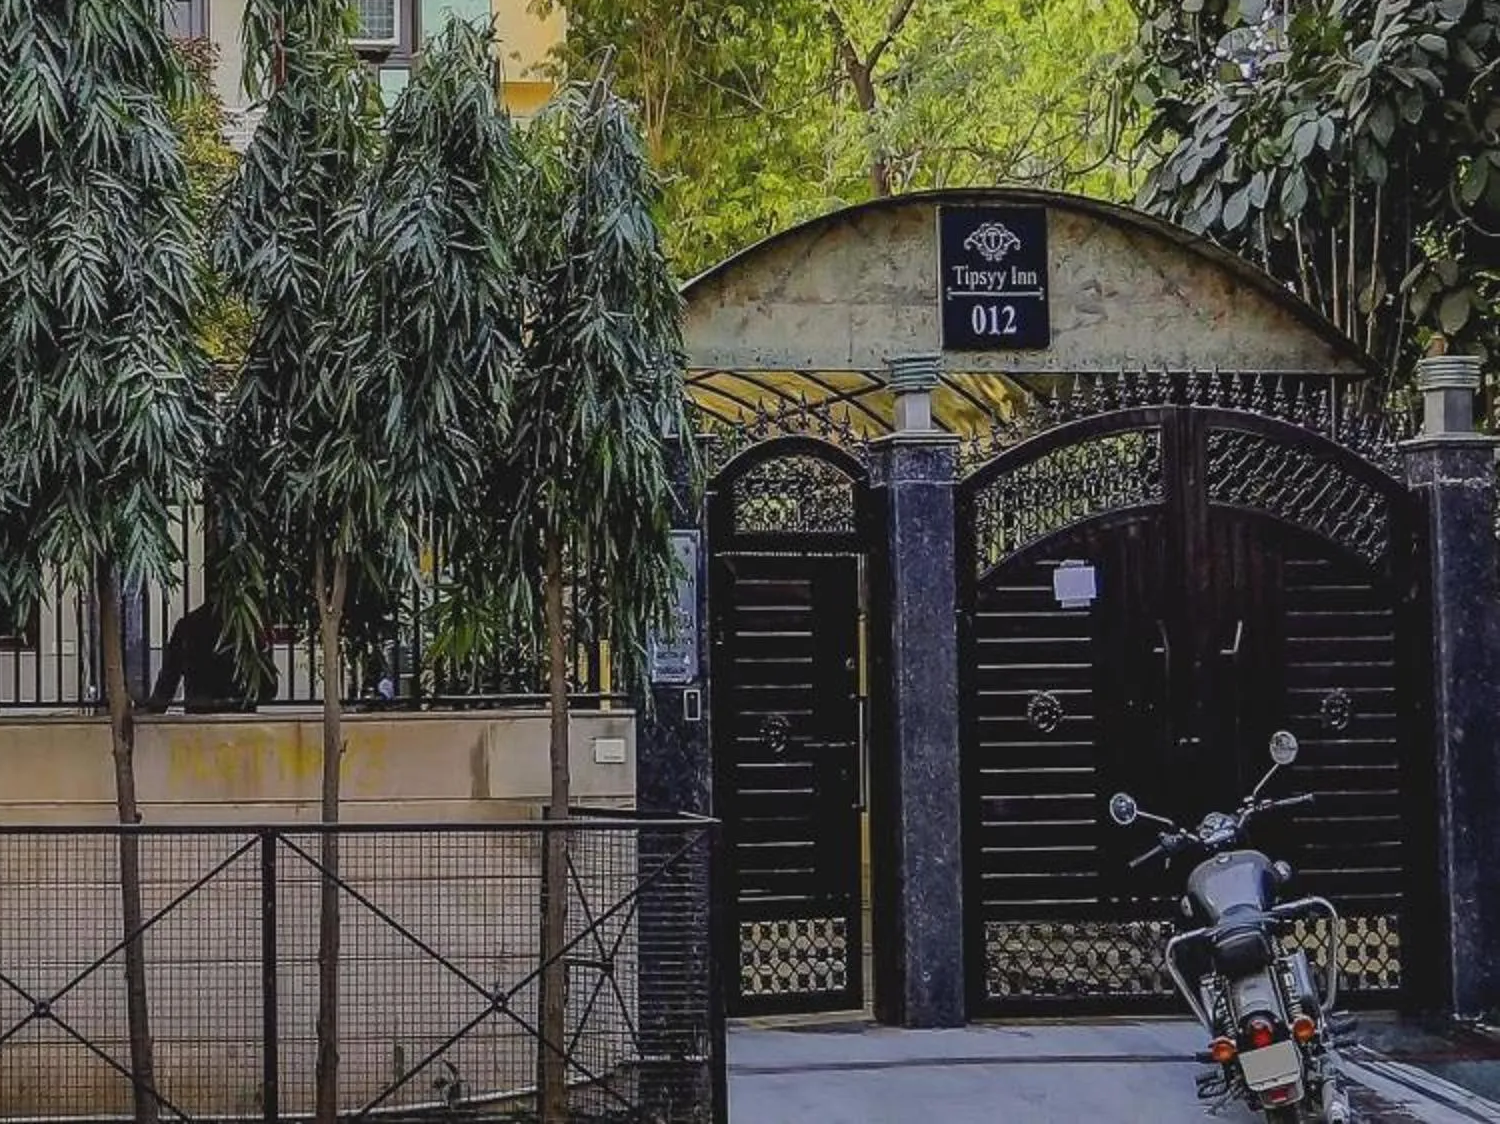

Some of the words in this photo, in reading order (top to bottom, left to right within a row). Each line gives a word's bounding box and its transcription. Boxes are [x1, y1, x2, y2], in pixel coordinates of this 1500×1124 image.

[951, 264, 1007, 291] Tipsyy
[1011, 265, 1037, 285] Inn
[971, 304, 1017, 335] 012
